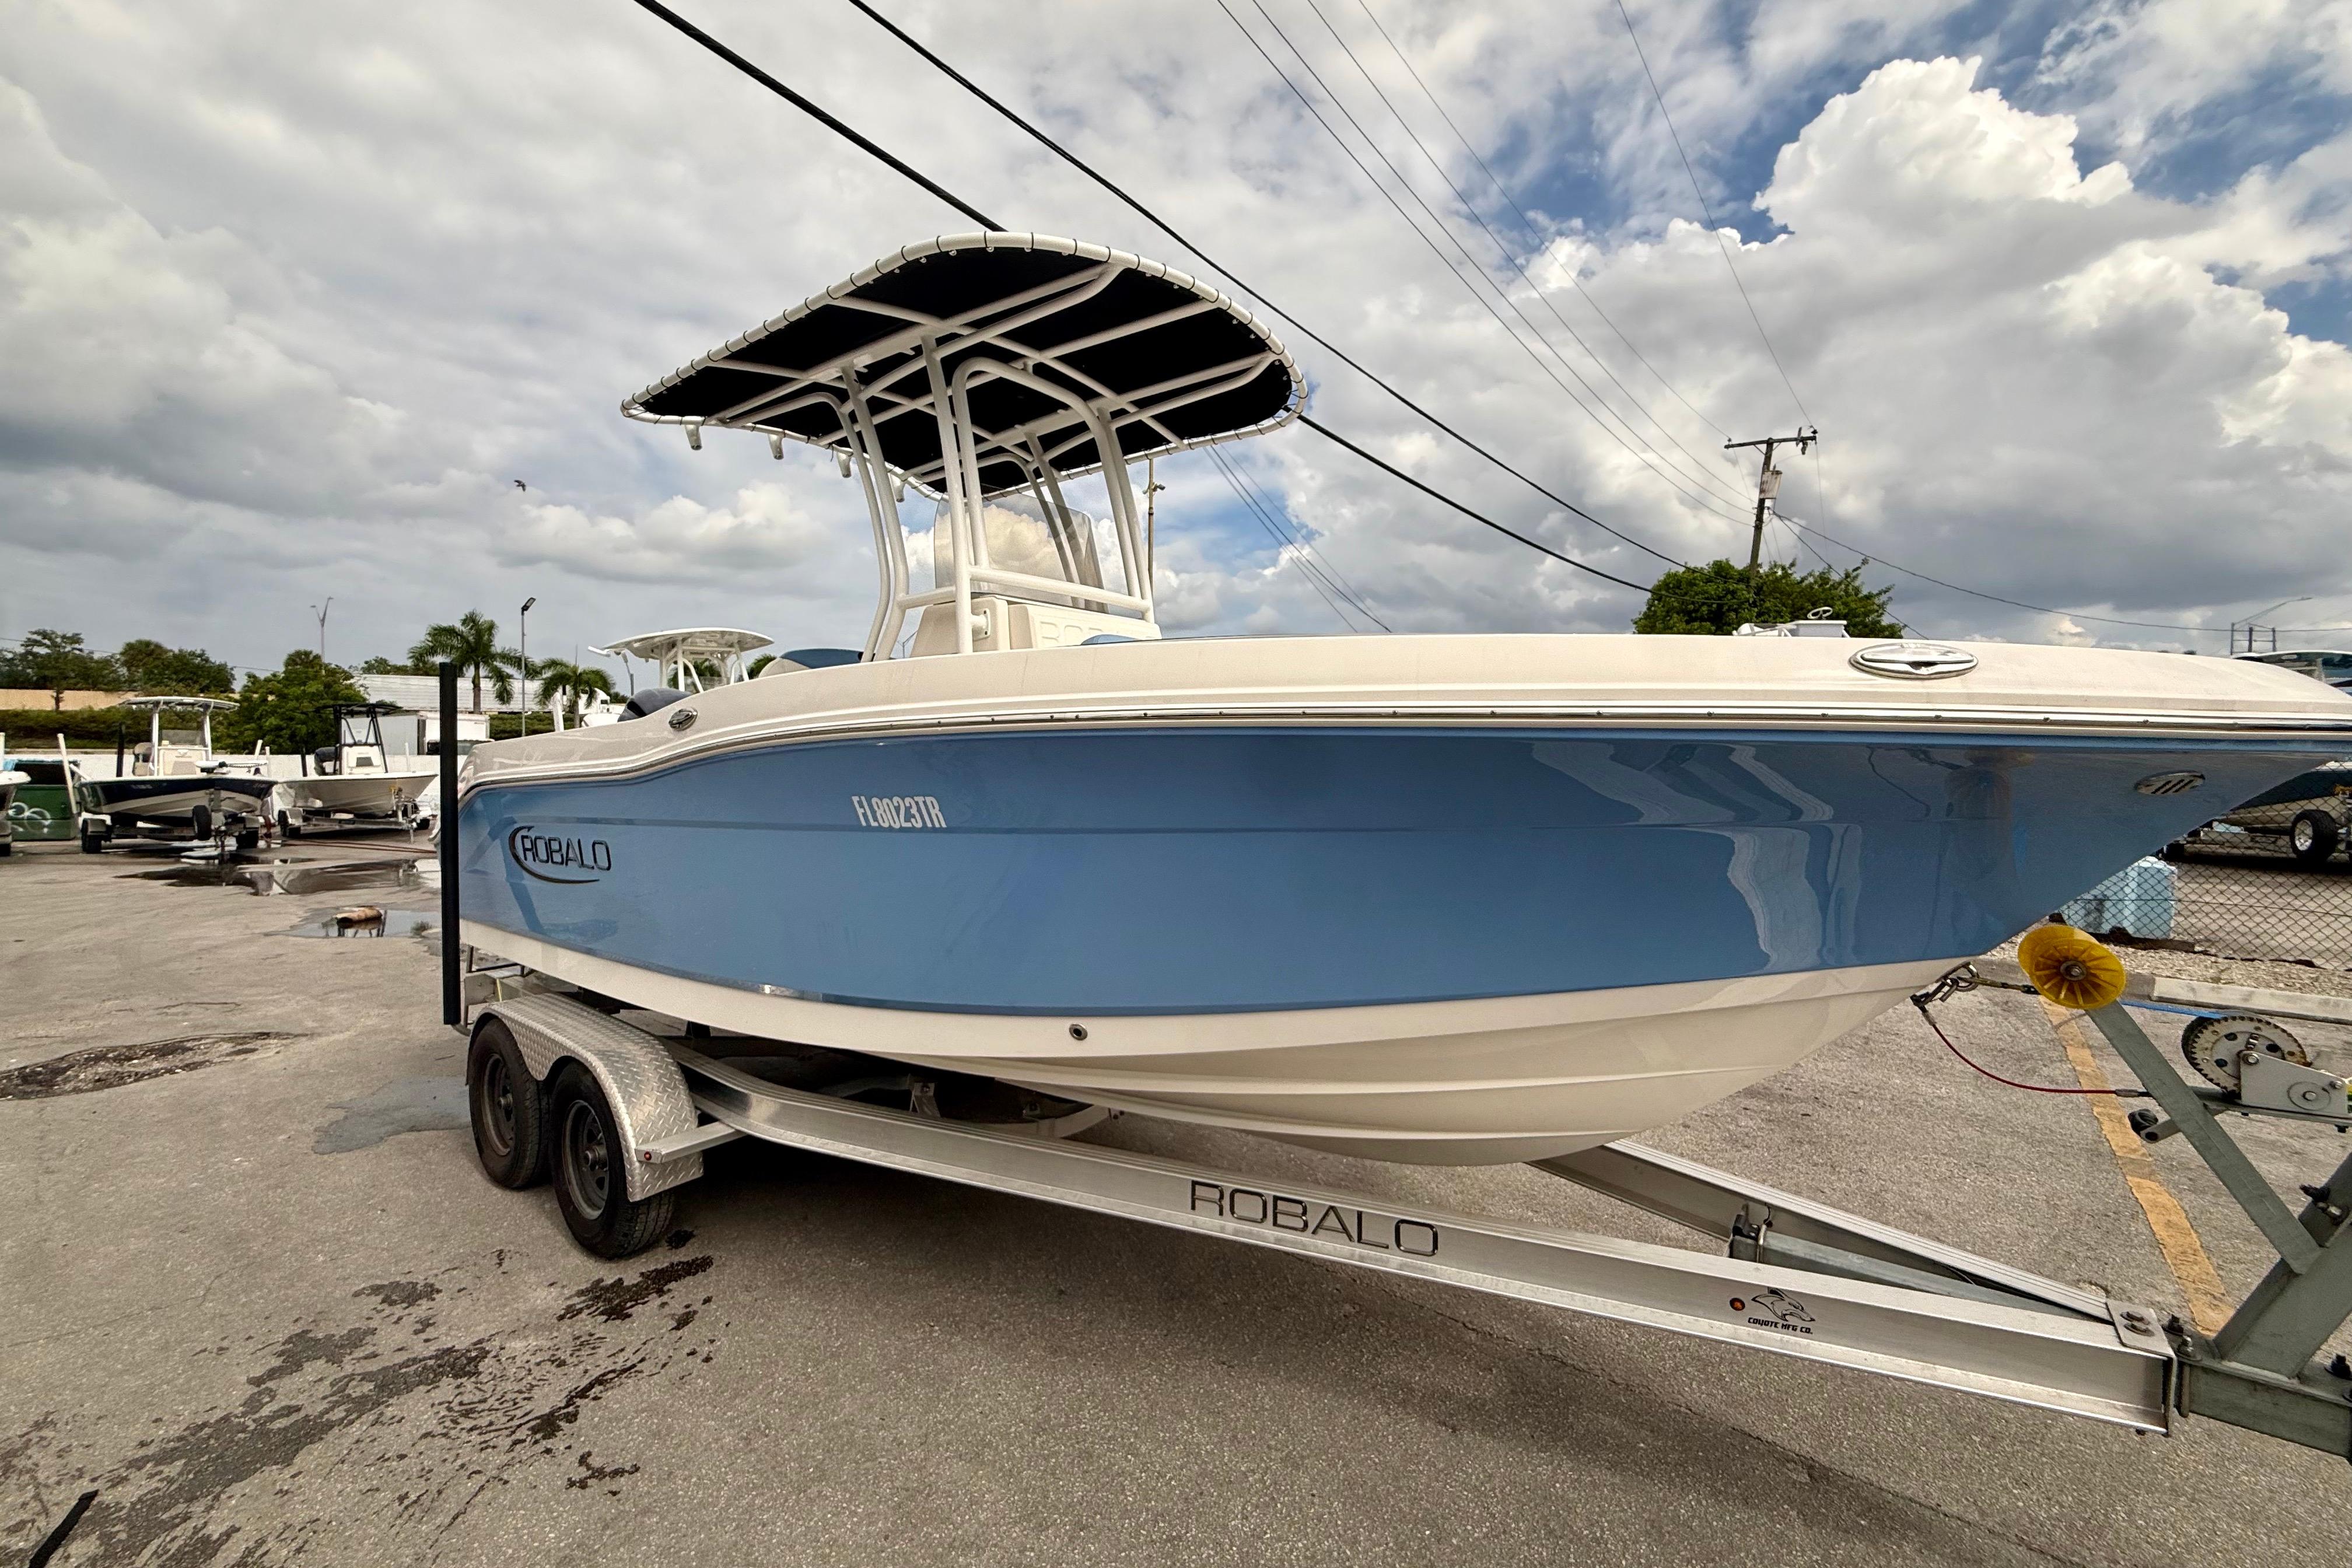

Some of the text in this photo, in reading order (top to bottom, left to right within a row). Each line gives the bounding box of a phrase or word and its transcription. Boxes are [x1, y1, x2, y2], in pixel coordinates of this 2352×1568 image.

[852, 796, 947, 828] FL8023TR
[520, 835, 612, 871] ROBALO
[1191, 1180, 1438, 1256] ROBALO
[1748, 1317, 1812, 1335] COYOTE MFG CO.
